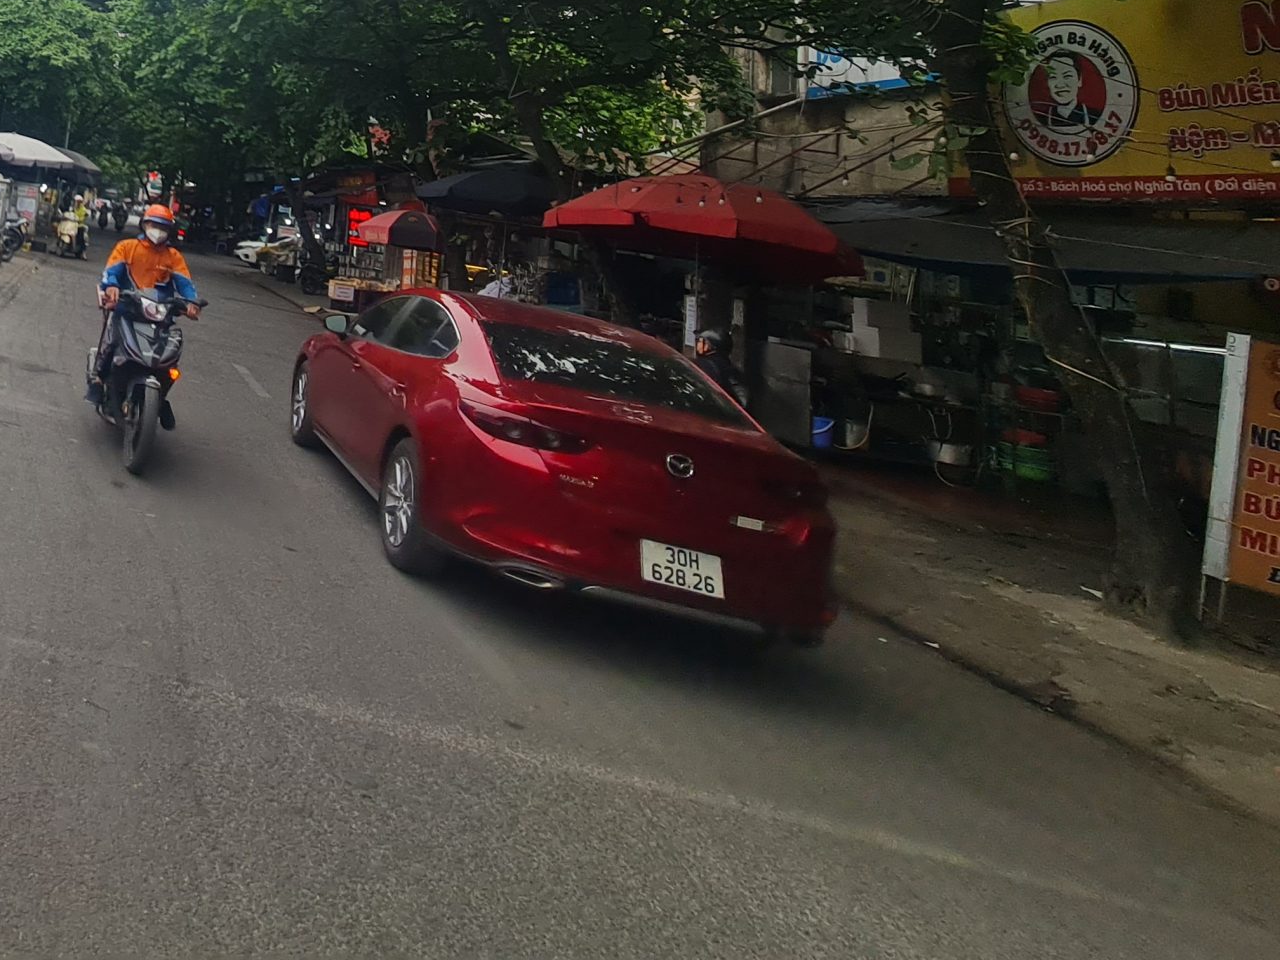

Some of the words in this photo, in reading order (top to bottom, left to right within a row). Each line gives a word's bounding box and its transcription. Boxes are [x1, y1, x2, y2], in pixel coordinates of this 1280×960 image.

[1158, 82, 1209, 111] Bún
[1168, 122, 1229, 158] Nộm
[666, 547, 699, 570] 30H
[651, 564, 715, 594] 628.26
